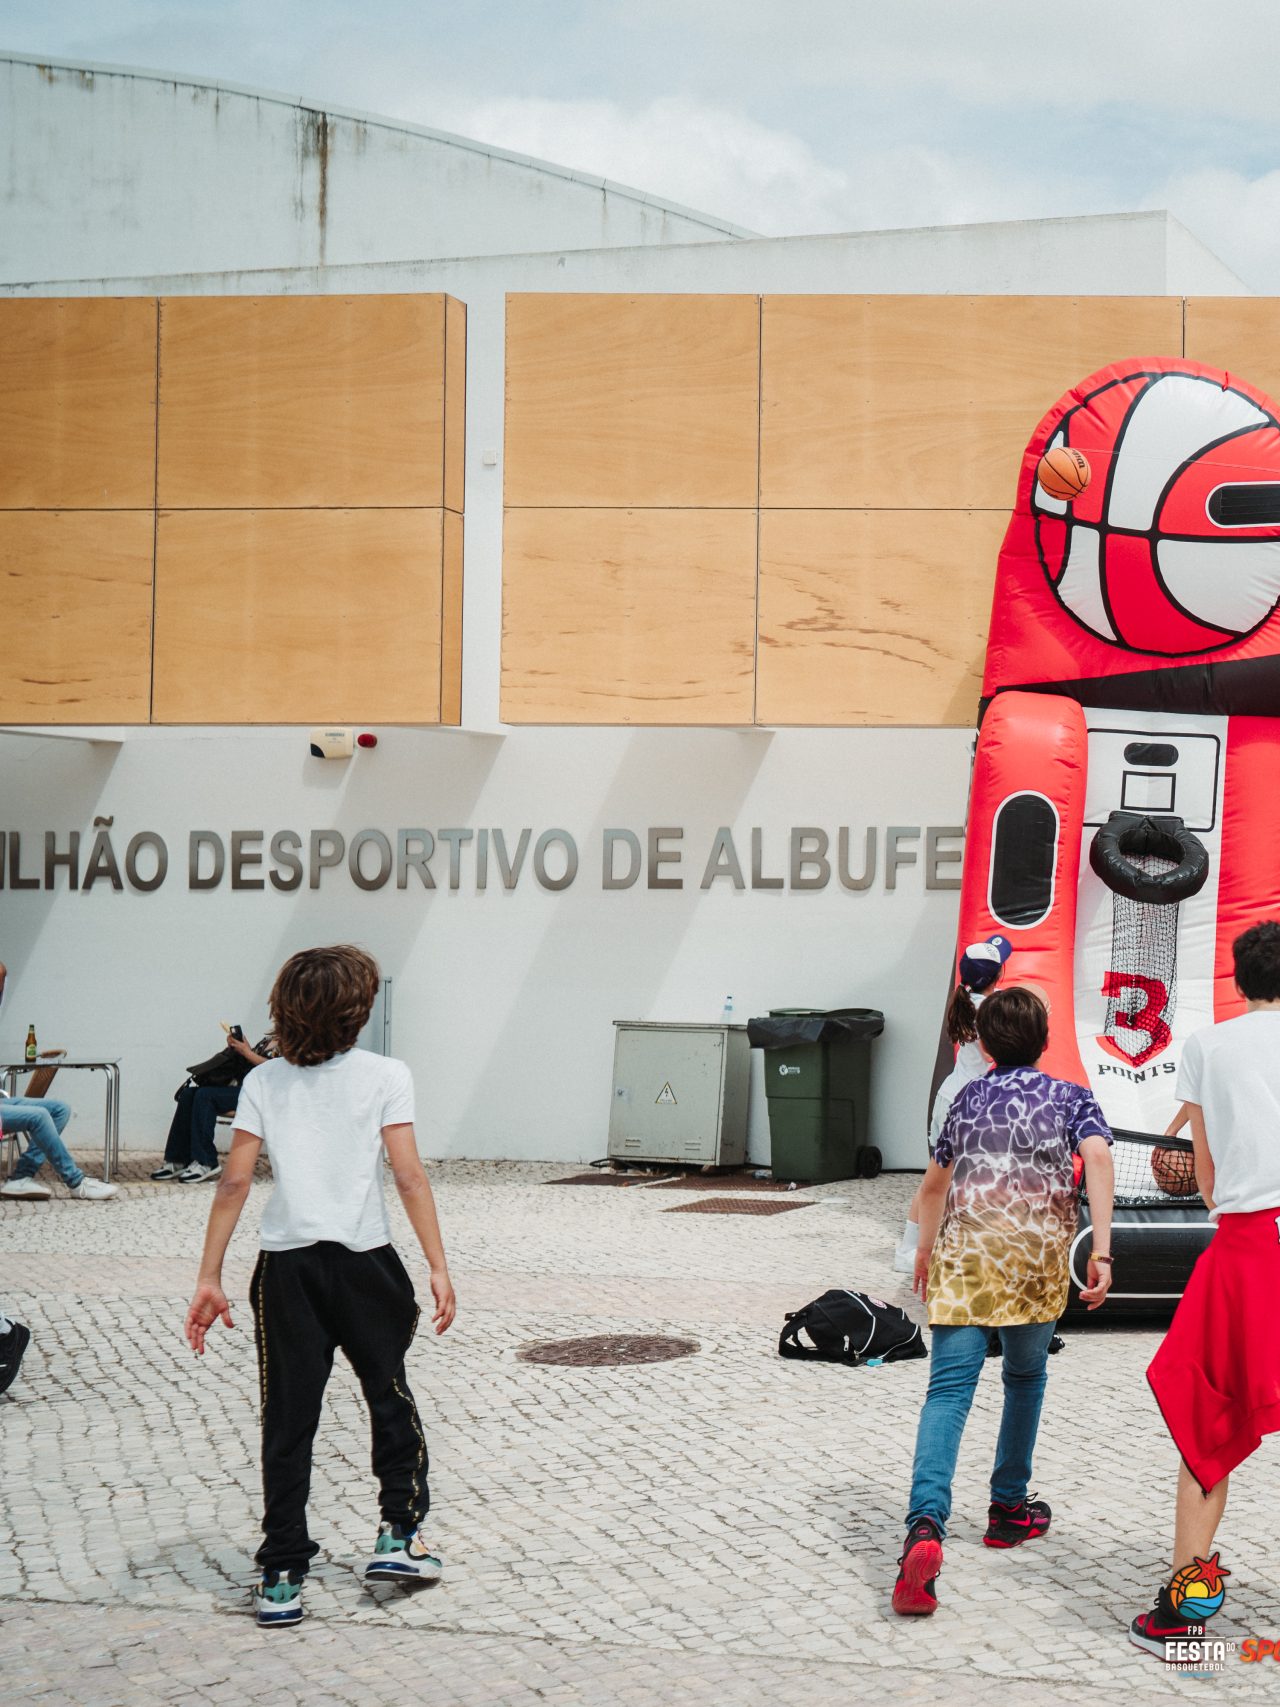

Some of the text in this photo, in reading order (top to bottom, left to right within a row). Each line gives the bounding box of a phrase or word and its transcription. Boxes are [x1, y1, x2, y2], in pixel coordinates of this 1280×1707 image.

[189, 828, 578, 892] DESPORTIVO
[602, 827, 684, 891] DE
[700, 826, 964, 891] ALBUFE
[1096, 971, 1173, 1068] 3
[1097, 1062, 1176, 1084] POINTS
